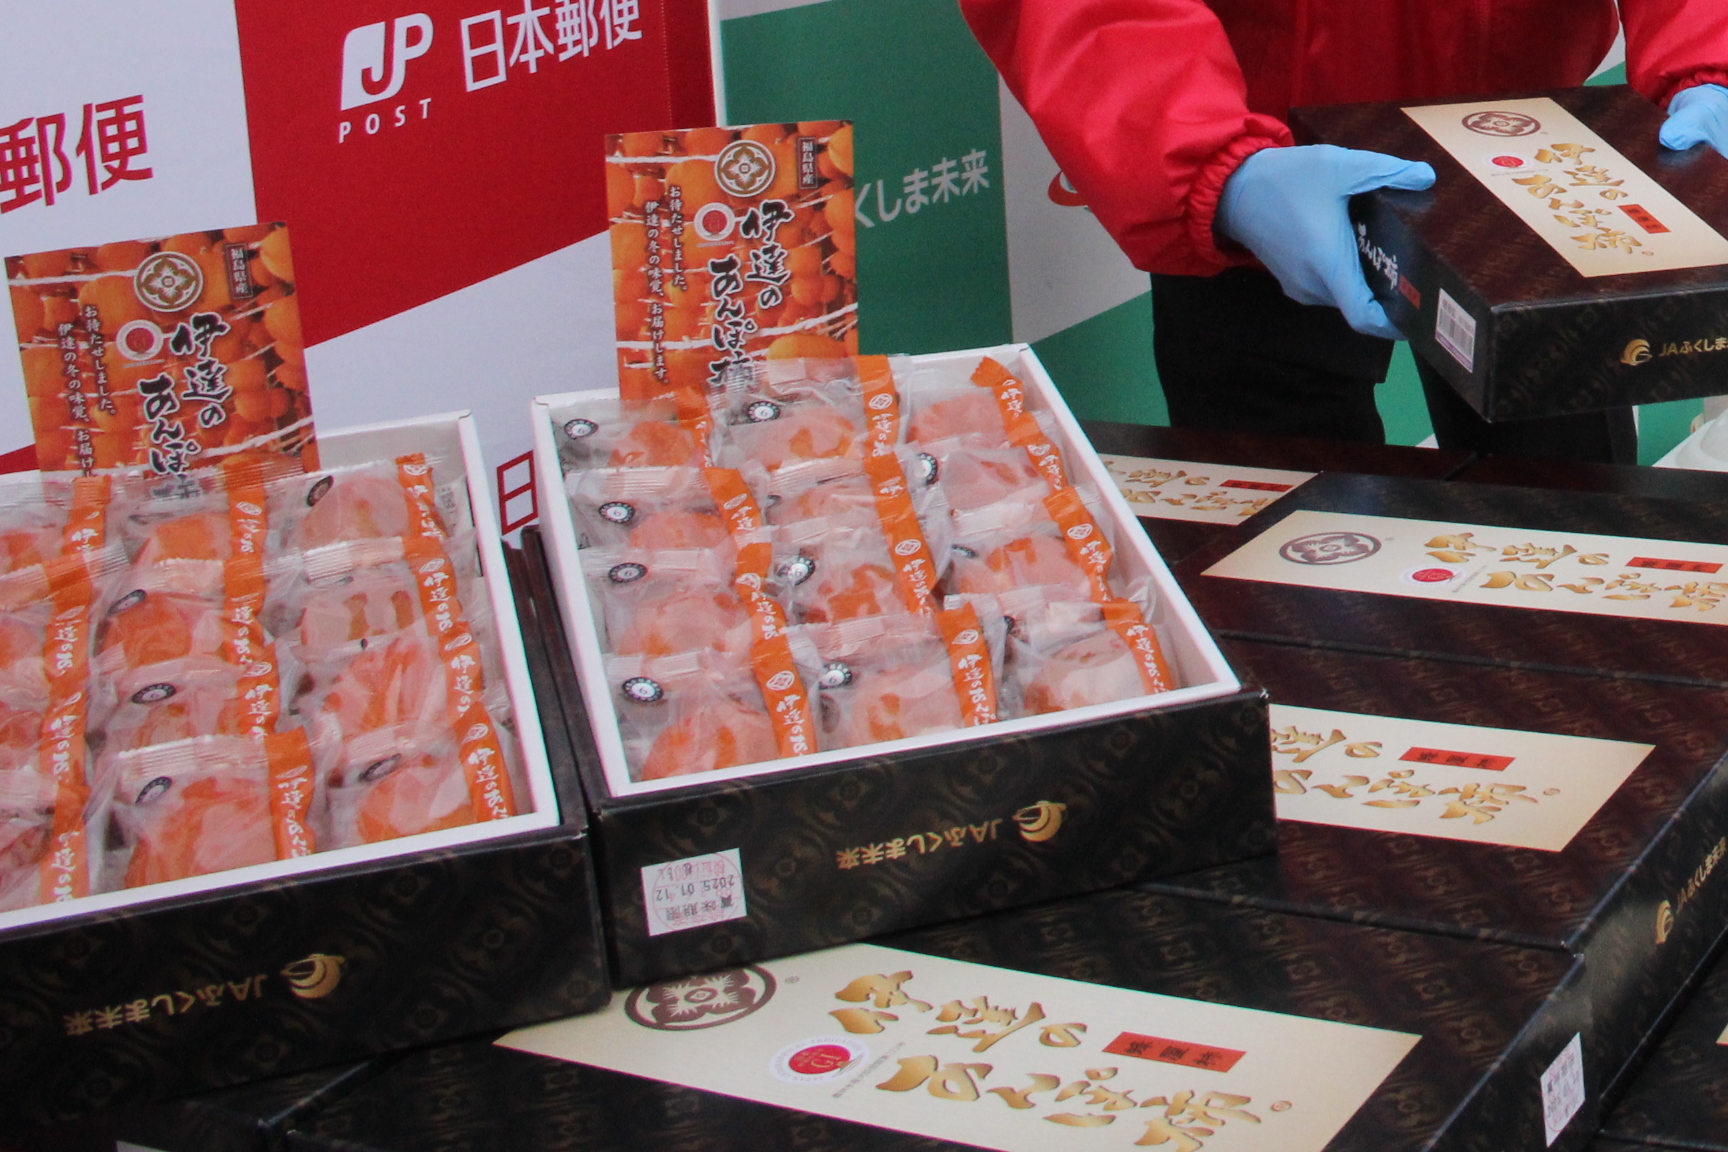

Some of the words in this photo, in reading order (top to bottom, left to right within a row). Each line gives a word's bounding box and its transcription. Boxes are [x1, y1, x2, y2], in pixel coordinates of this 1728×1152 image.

[338, 97, 432, 144] POST
[801, 140, 816, 185] 福島県産
[230, 248, 250, 295] 福島県産
[668, 185, 689, 292] お待たせしました。
[740, 198, 795, 310] 伊達の
[83, 305, 117, 417] お待たせしました。
[170, 312, 233, 428] 伊達の
[836, 818, 1003, 870] JAふくしま未来
[65, 973, 268, 1037] JAふくしま未来
[828, 969, 1088, 1054] 伊達の
